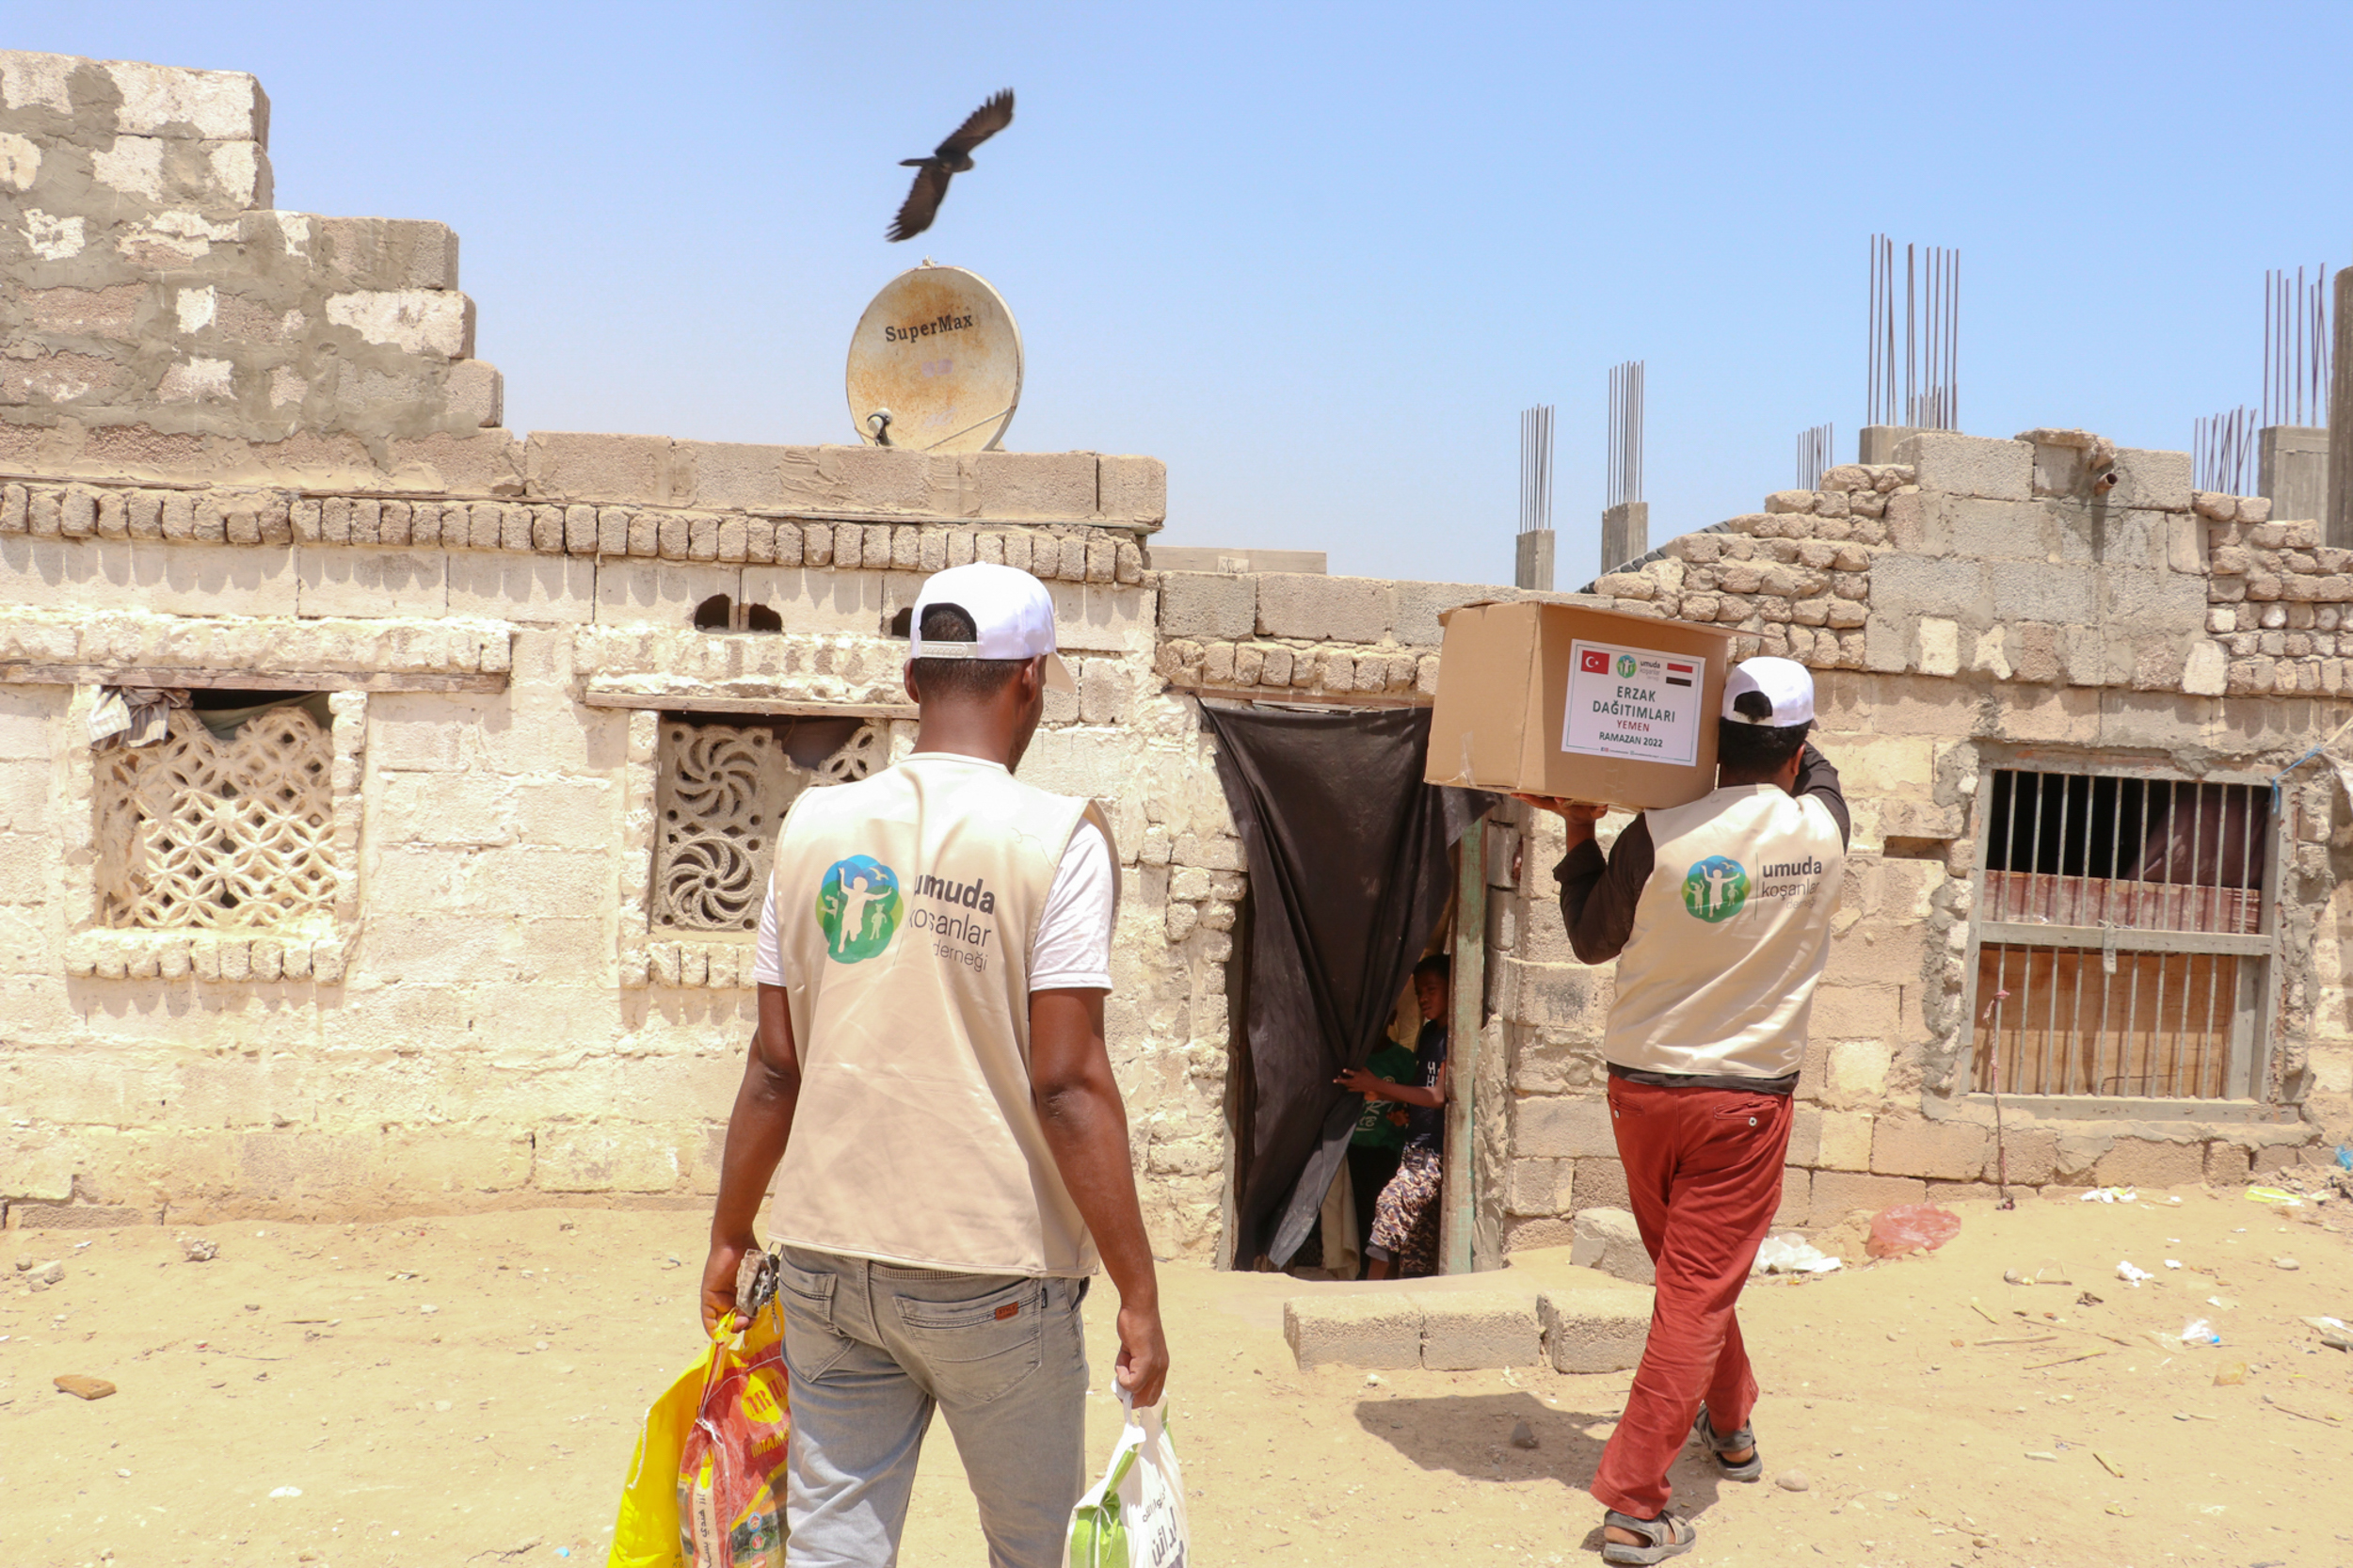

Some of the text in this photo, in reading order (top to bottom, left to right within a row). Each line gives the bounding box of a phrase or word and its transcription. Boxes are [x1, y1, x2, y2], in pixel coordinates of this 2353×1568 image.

[885, 313, 973, 344] SuperMax
[1640, 660, 1661, 669] umuda
[1617, 685, 1657, 702] ERZAK
[1593, 699, 1675, 723] DAĞITIMLARI
[1616, 719, 1650, 732] YEMEN
[1599, 731, 1663, 748] RAMAZAN 2022
[1762, 856, 1822, 878] umuda
[1761, 878, 1820, 901] koşanlar
[932, 941, 988, 973] derneği
